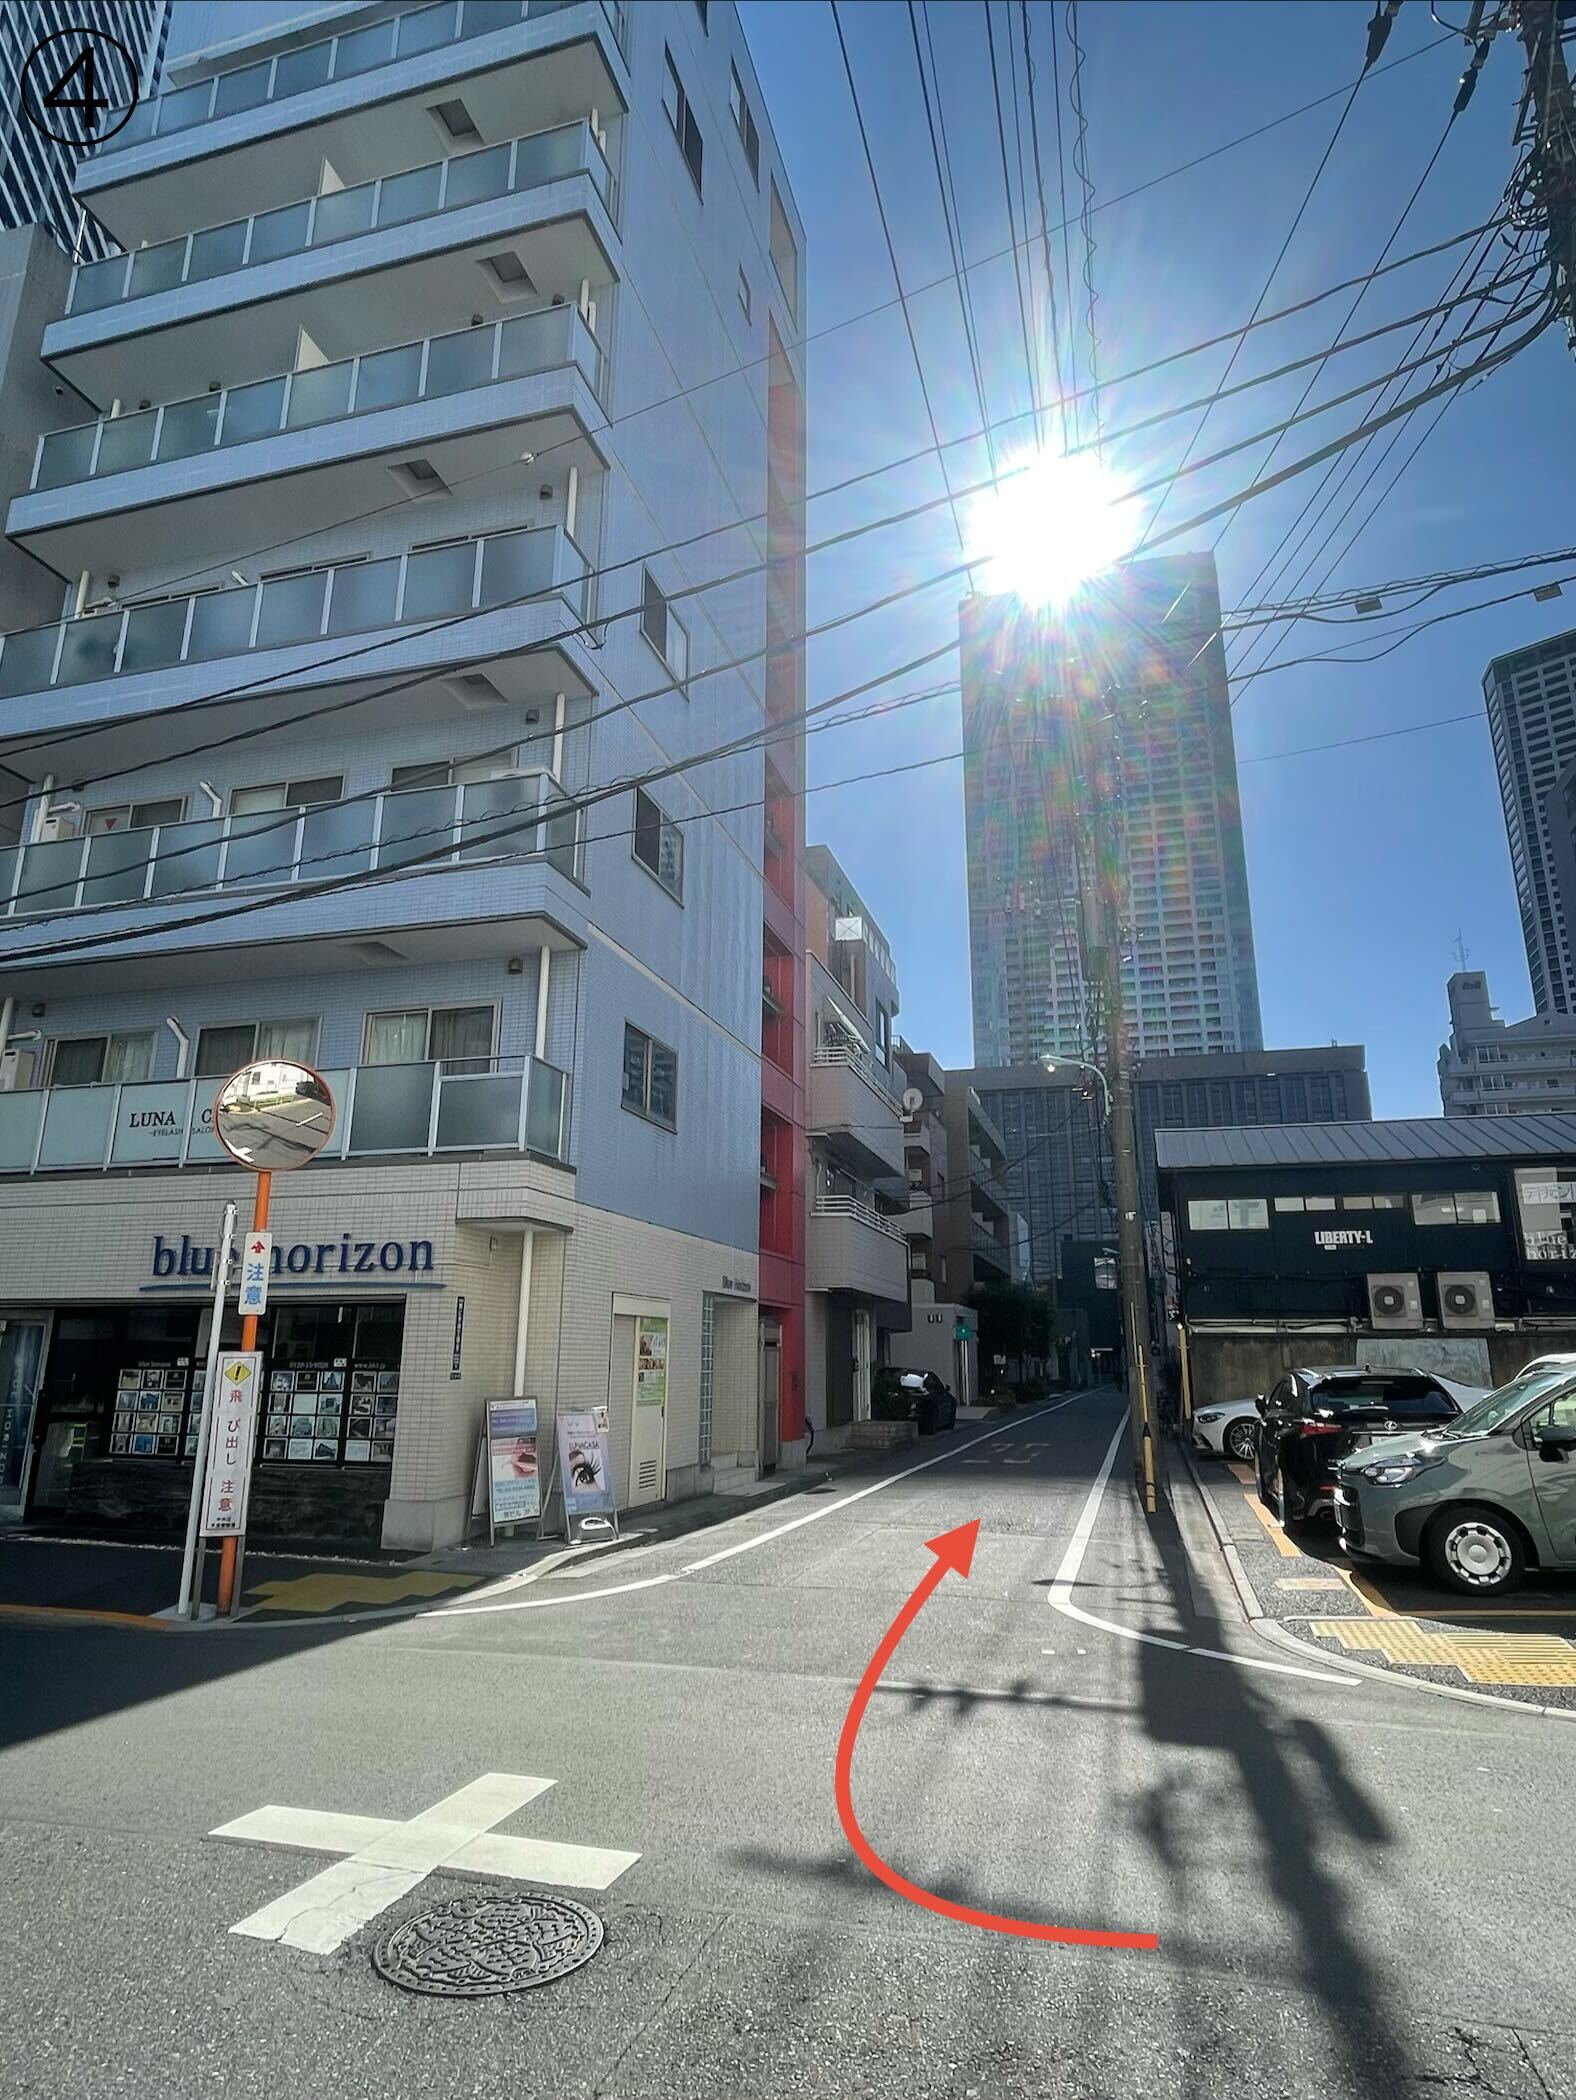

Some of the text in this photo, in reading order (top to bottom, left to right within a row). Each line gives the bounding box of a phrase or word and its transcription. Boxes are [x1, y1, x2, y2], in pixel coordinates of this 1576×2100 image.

[129, 1111, 176, 1127] LUNA
[191, 1126, 215, 1135] SALO
[1314, 1230, 1373, 1245] LIBERTY-L
[1523, 1231, 1567, 1245] blue
[244, 1262, 264, 1305] 注意
